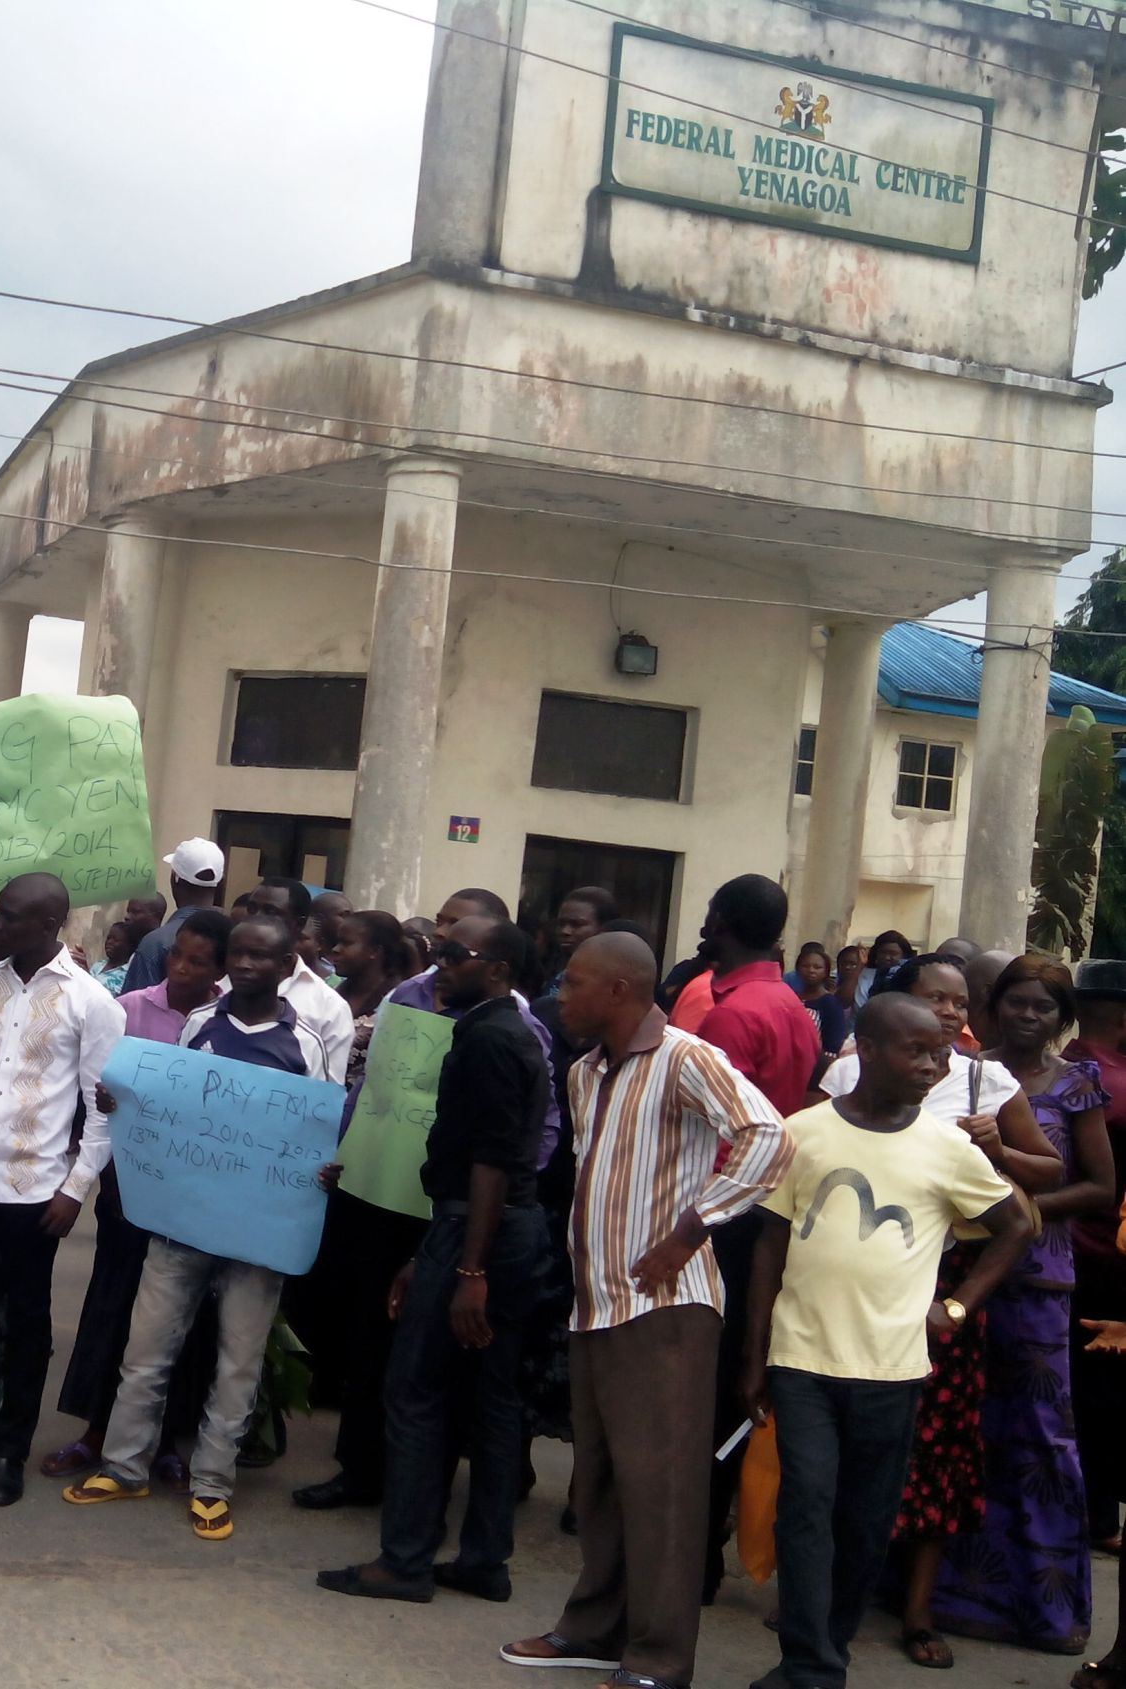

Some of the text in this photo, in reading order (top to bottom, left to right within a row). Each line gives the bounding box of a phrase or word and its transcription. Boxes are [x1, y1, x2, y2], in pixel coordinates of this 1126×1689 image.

[626, 108, 967, 205] FEDERAL MEDICAL CENTRE
[737, 166, 852, 217] YENAGOA
[68, 715, 140, 769] PAY
[55, 767, 140, 819] YEN
[456, 824, 472, 842] 12
[71, 857, 155, 893] STEPING
[201, 1068, 256, 1114] PAY
[122, 1147, 165, 1181] TIVES
[127, 1124, 161, 1144] 13TH
[165, 1139, 252, 1173] MONTH
